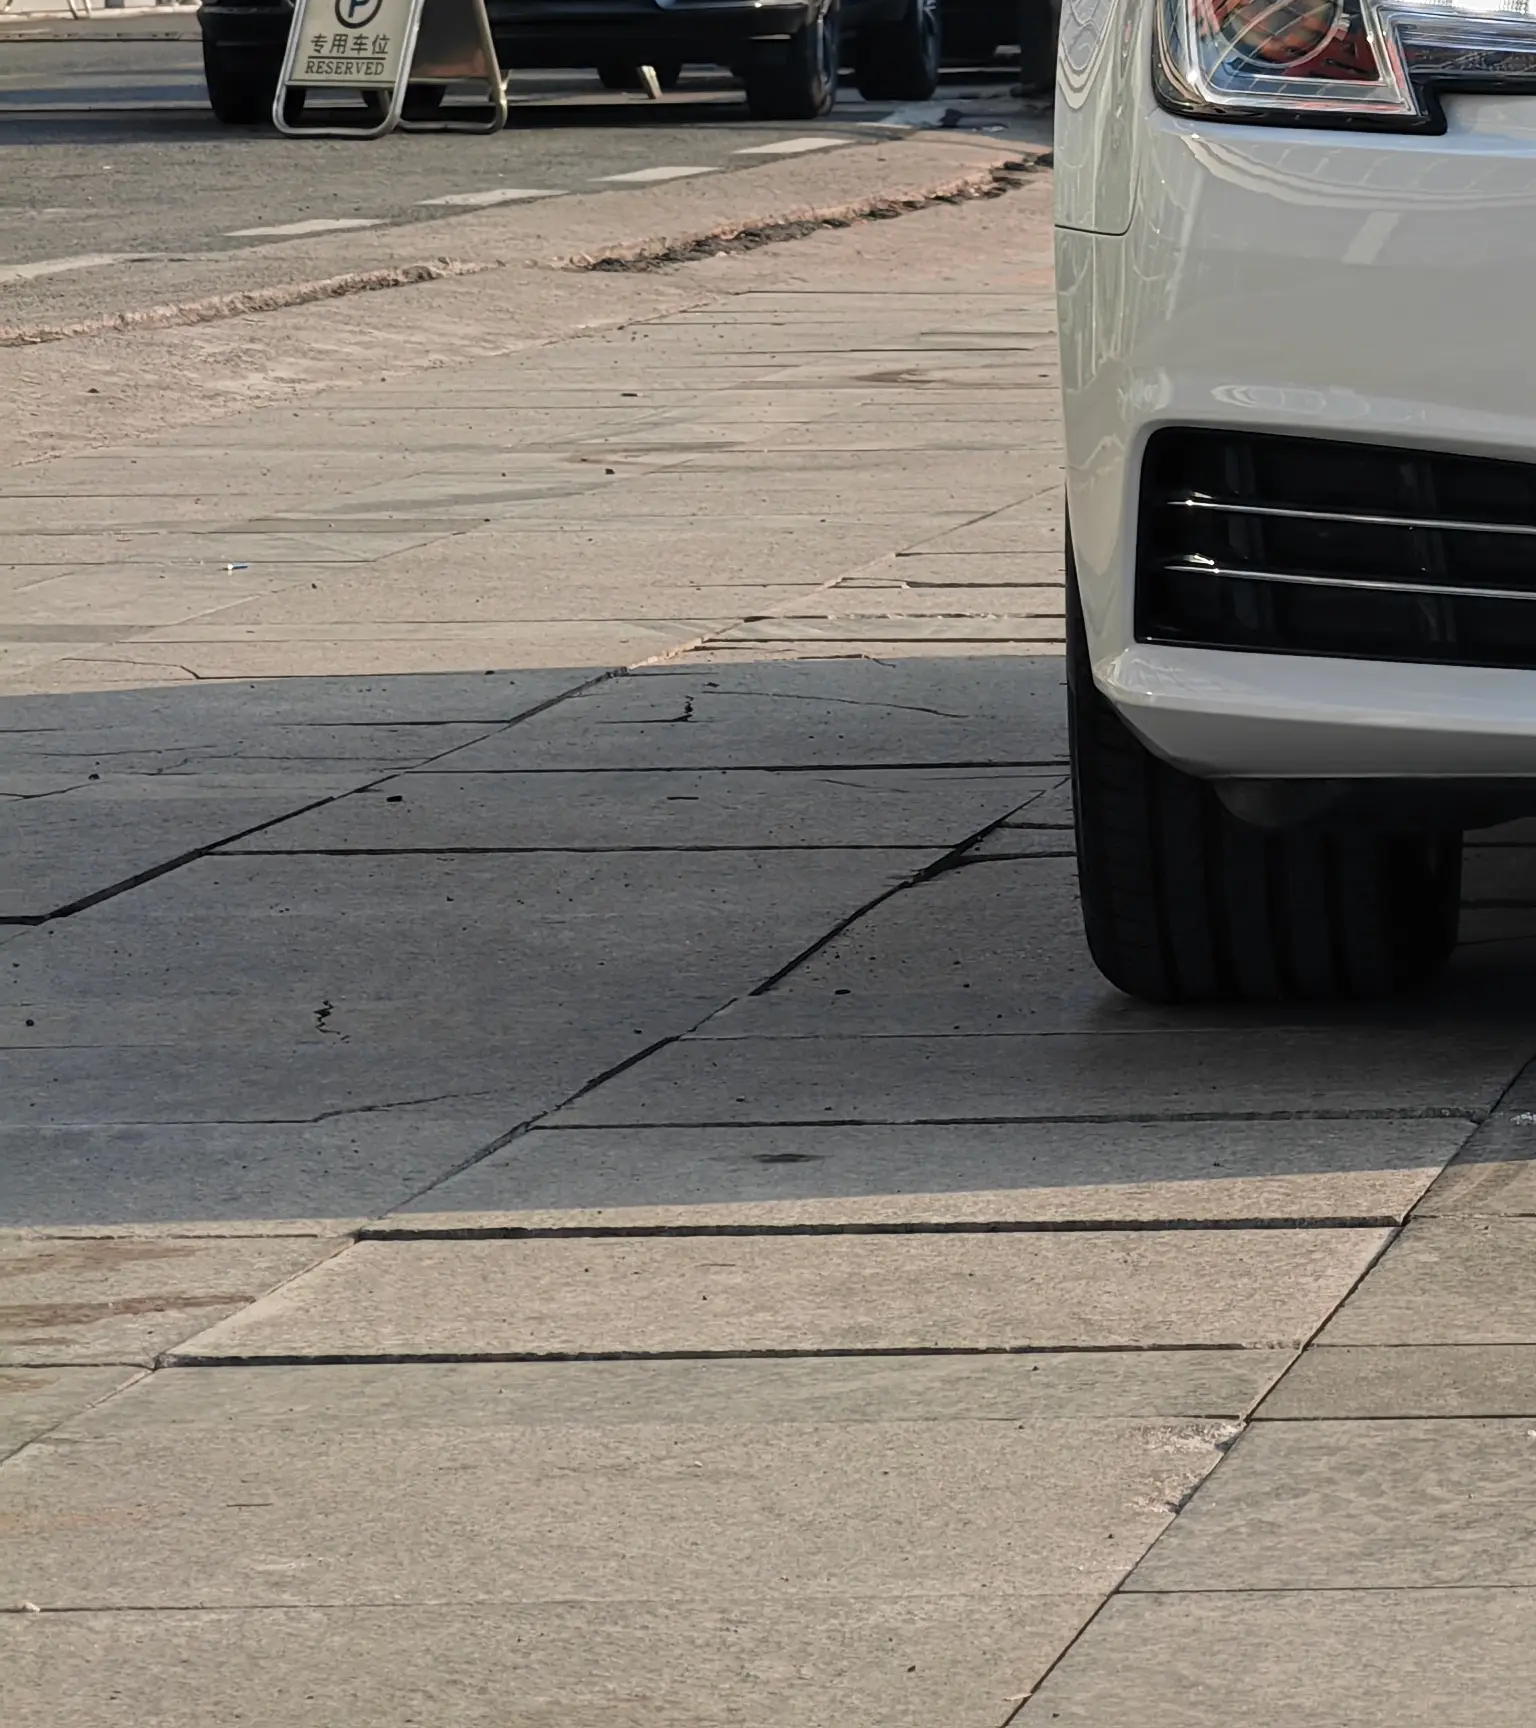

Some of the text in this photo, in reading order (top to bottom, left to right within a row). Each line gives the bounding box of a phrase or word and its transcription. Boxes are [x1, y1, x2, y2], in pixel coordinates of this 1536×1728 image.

[310, 33, 391, 56] 专用车位
[305, 60, 385, 76] RESERVED
